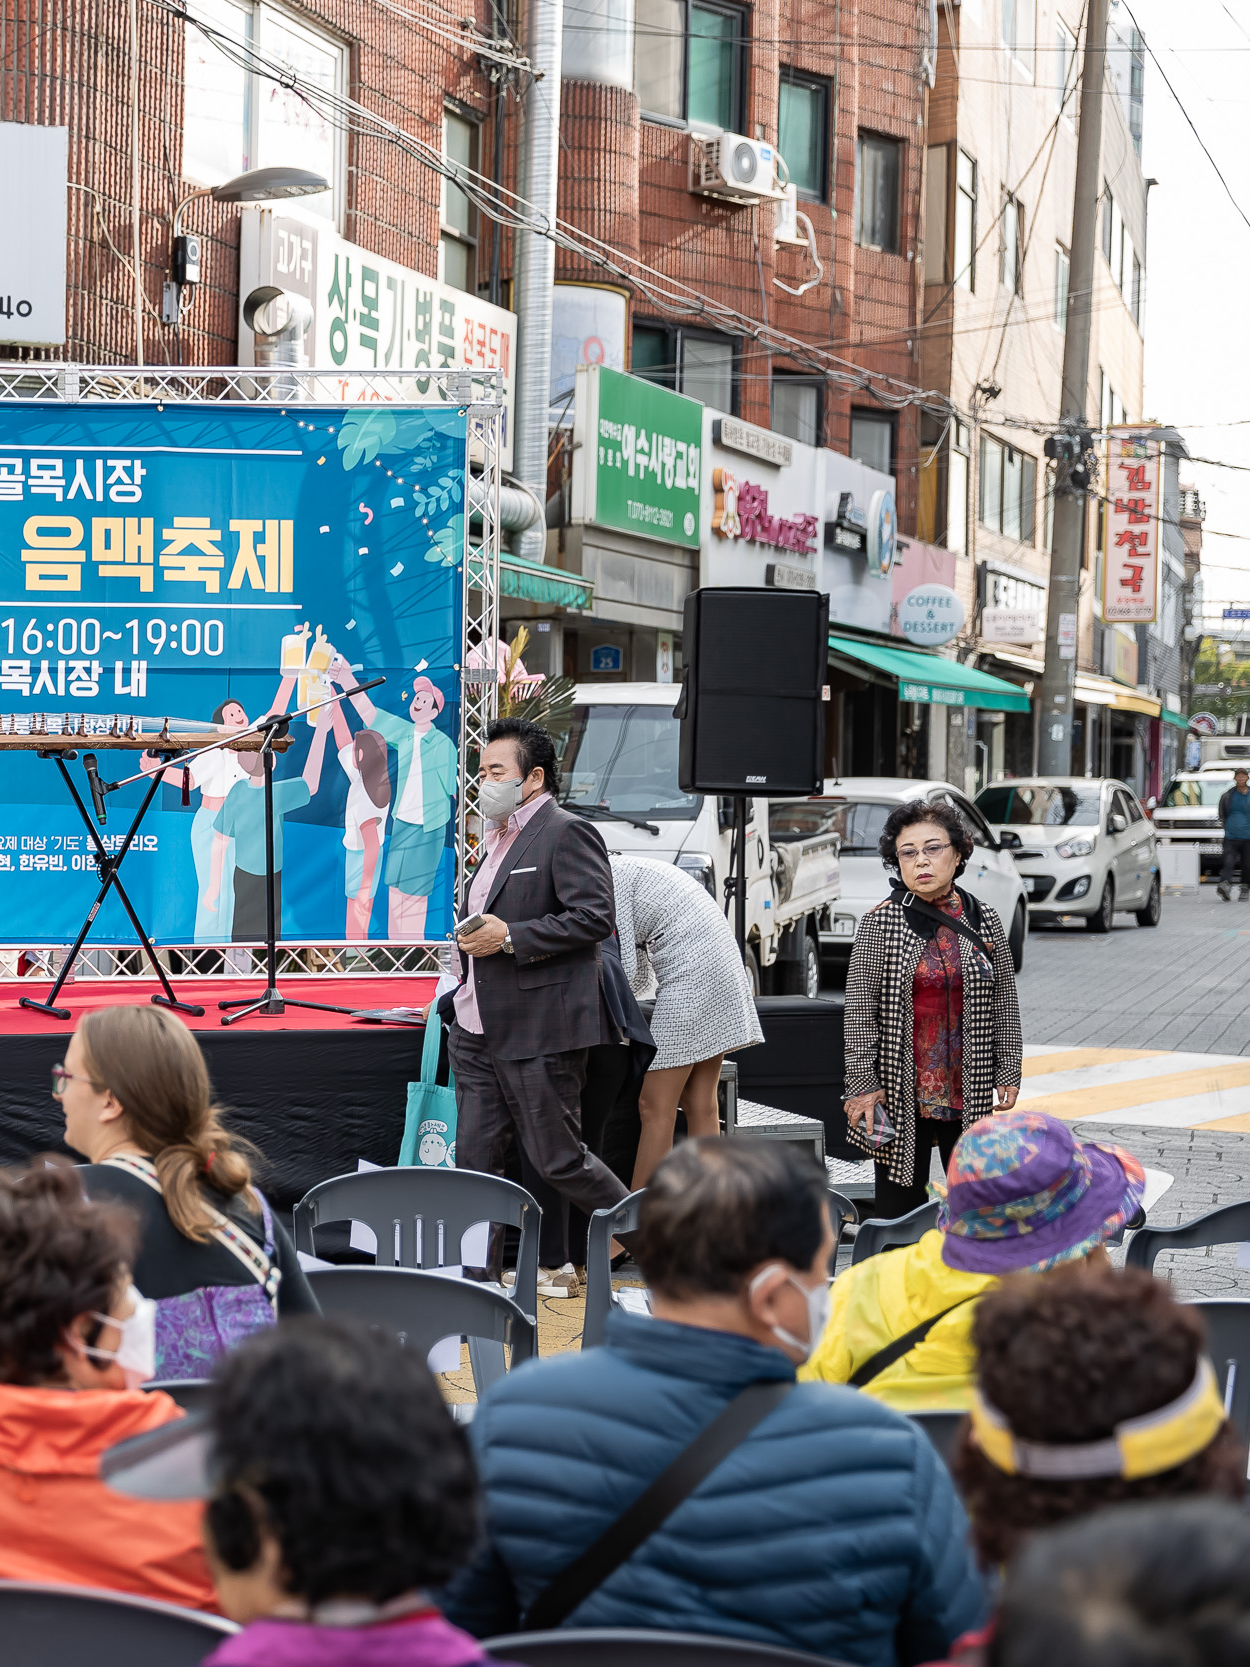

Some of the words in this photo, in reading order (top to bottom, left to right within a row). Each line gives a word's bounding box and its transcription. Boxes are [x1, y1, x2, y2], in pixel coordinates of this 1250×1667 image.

[276, 229, 312, 284] 고가구
[20, 514, 295, 594] 음맥축제
[906, 594, 953, 609] COFFEE
[0, 618, 225, 657] 16:00~19:00
[902, 621, 956, 634] DESSERT
[113, 658, 148, 699] 내
[20, 836, 48, 851] 대상
[18, 854, 68, 872] 한유빈,
